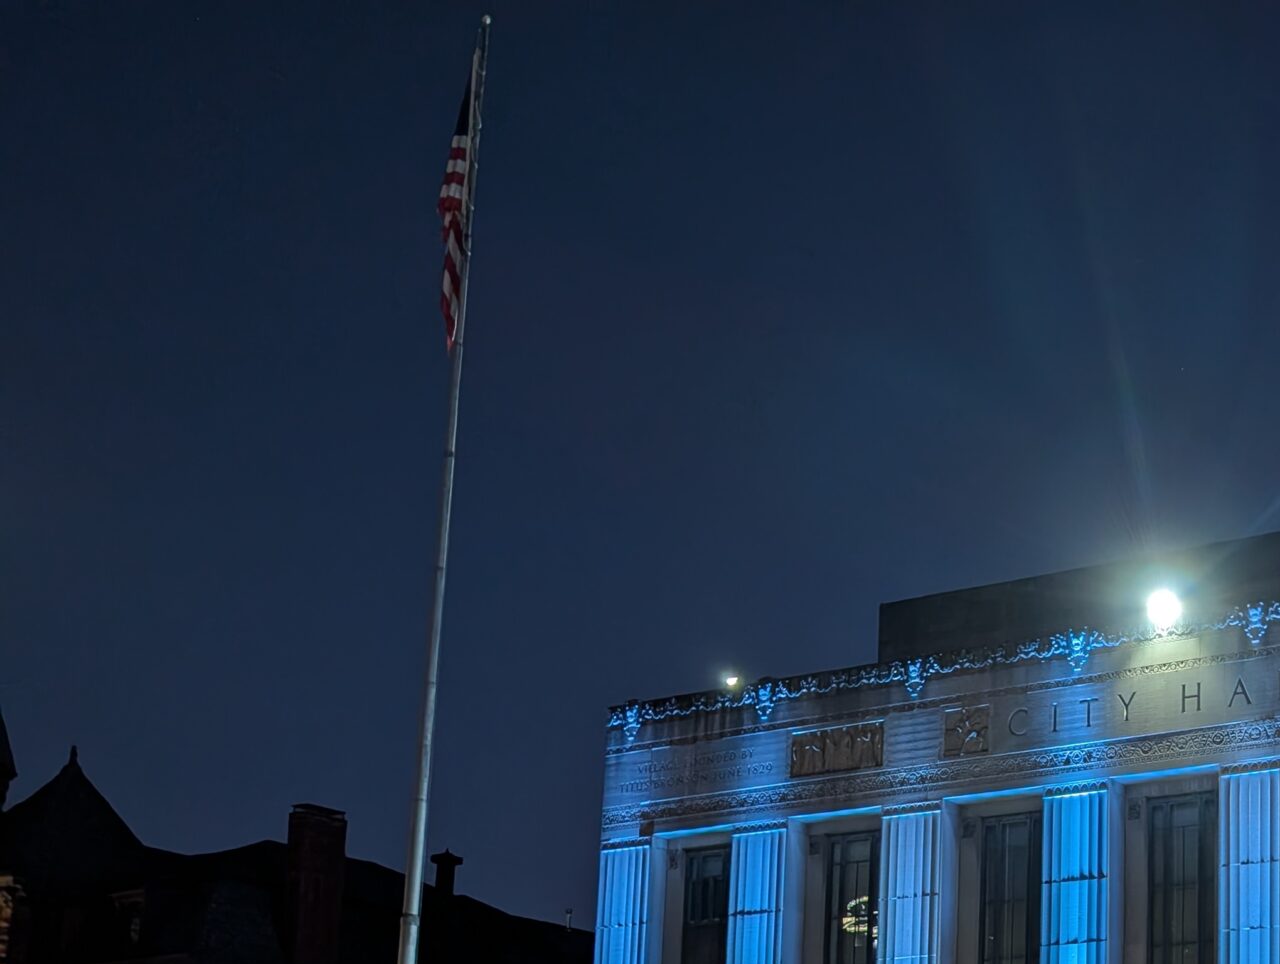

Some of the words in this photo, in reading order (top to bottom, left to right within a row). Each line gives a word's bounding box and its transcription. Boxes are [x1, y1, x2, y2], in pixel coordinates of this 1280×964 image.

[1007, 691, 1137, 736] CITY
[741, 748, 755, 760] BY
[618, 782, 650, 794] TITUS
[713, 766, 742, 782] JUNE
[747, 763, 774, 776] 1829
